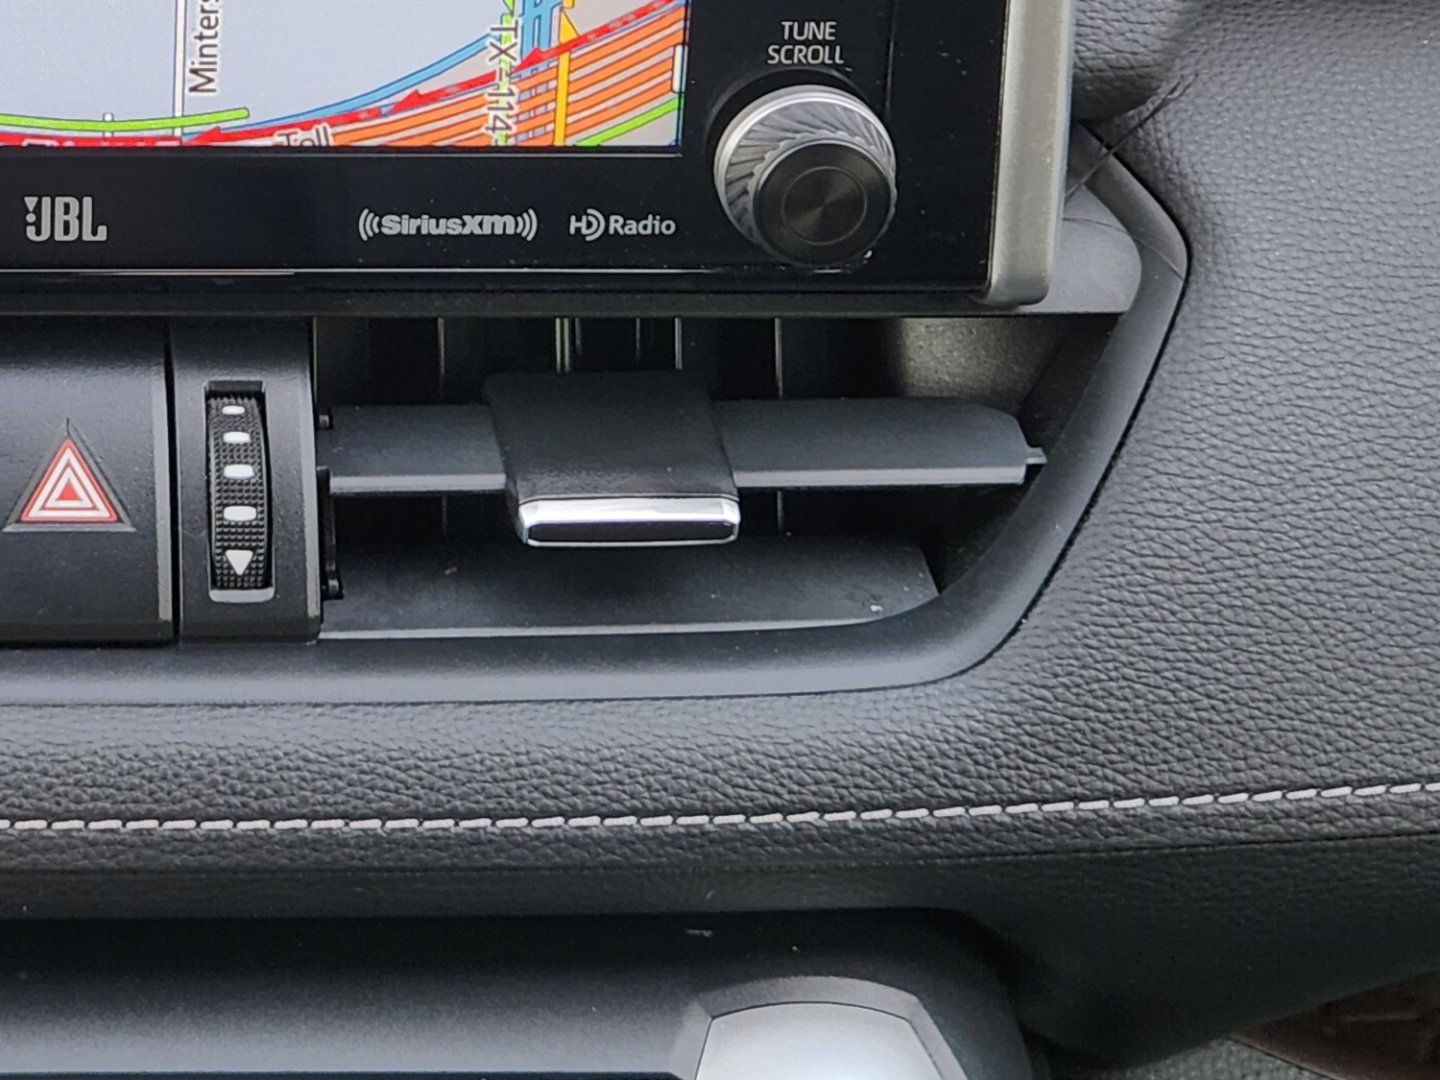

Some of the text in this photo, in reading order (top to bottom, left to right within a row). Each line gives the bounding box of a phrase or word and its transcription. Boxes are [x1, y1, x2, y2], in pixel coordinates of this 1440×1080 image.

[782, 22, 836, 41] TUNE
[768, 45, 845, 65] SCROLL
[484, 19, 519, 133] TX-114
[25, 196, 107, 242] JBL
[569, 208, 676, 241] HD Radio
